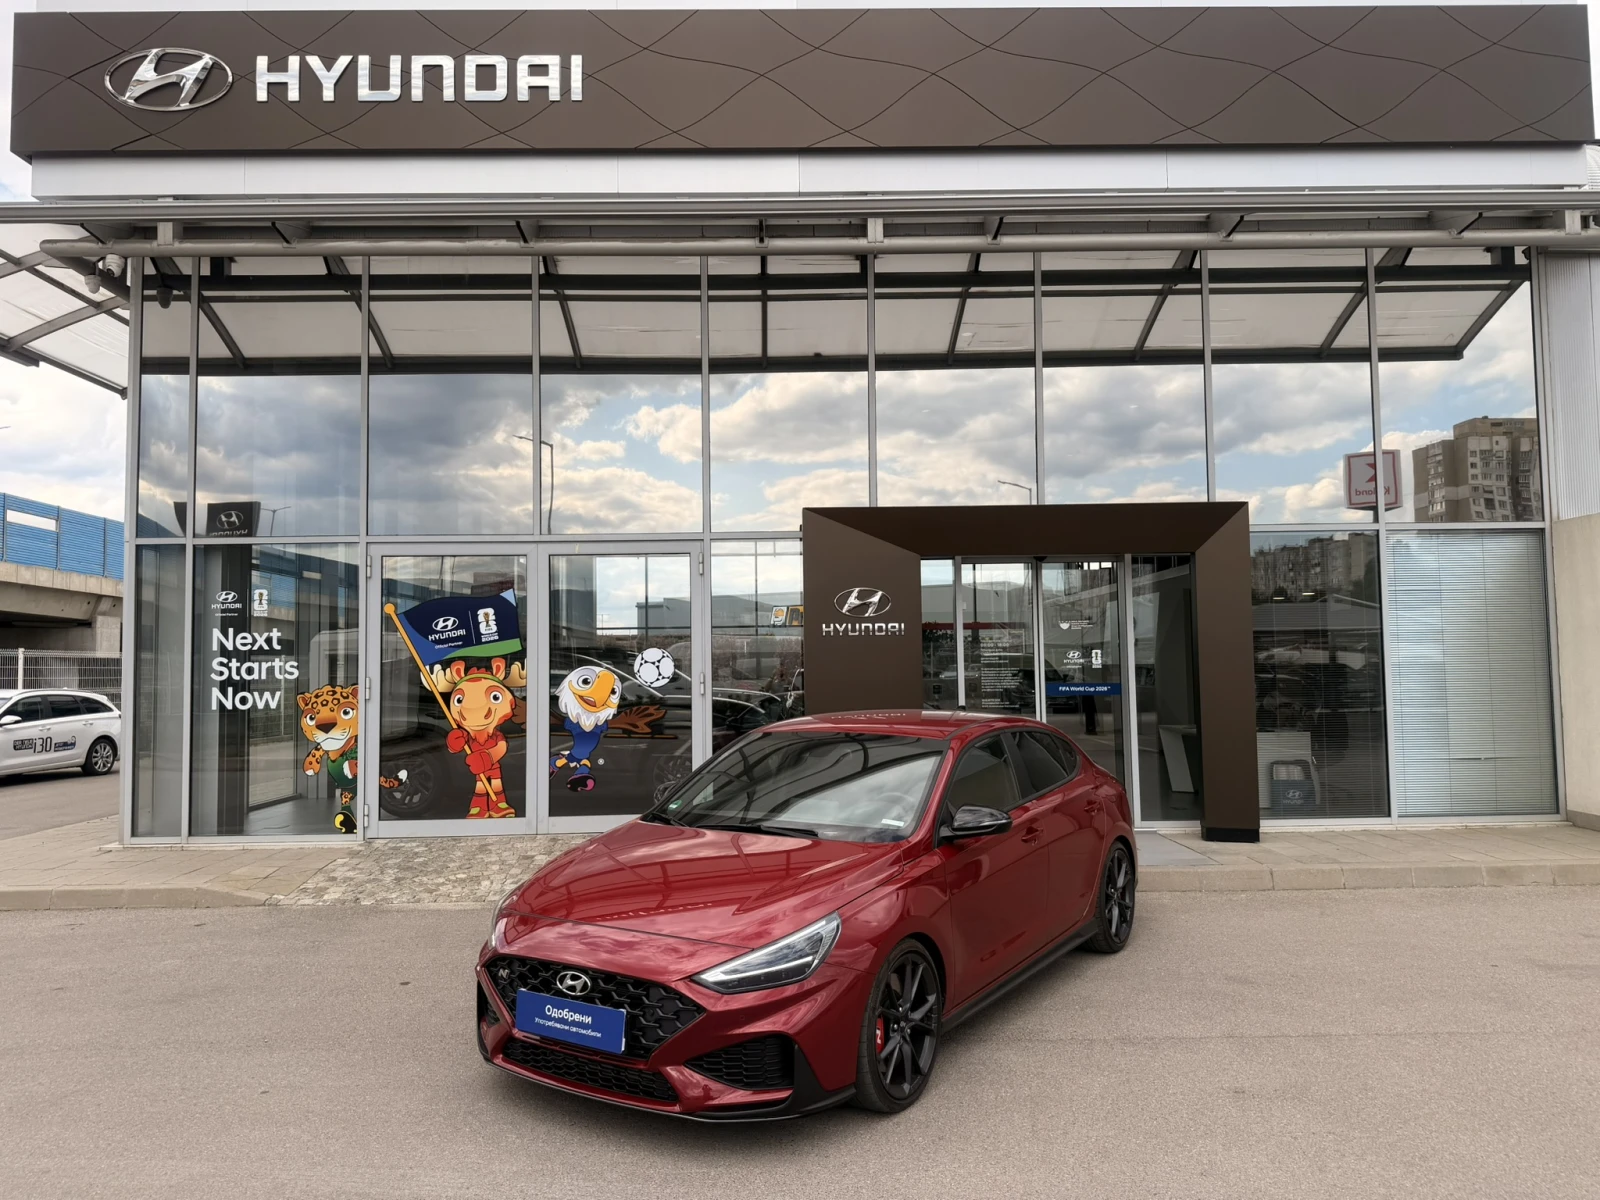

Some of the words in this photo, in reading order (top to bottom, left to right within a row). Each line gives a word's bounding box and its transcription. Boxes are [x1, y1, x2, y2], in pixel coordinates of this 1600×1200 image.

[255, 54, 584, 103] HYUNDAI
[211, 627, 282, 651] Next
[428, 629, 466, 642] HYUNDAI
[821, 622, 905, 636] HYUNDAI
[210, 657, 299, 681] Starts
[211, 686, 281, 711] Now
[33, 736, 53, 754] i30
[545, 1004, 592, 1024] Одобрени
[535, 1017, 569, 1030] Употребявани
[570, 1026, 602, 1037] автомобили
